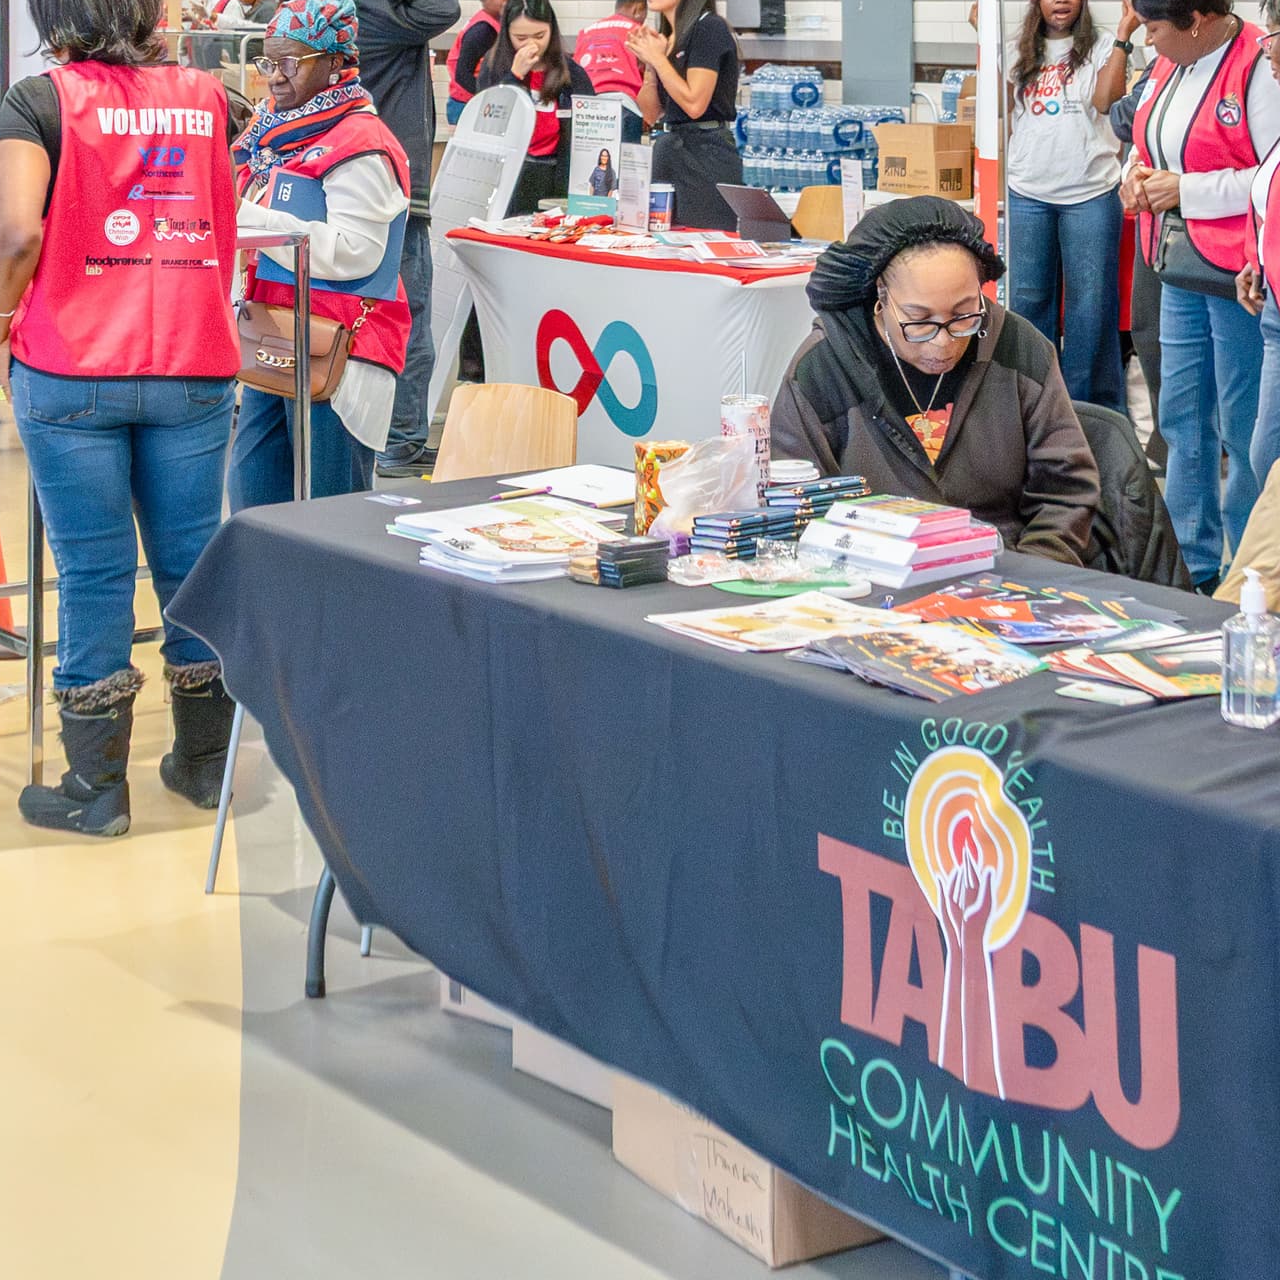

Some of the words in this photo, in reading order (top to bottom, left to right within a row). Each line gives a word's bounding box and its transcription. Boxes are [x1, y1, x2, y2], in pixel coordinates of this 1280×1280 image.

[97, 107, 213, 138] VOLUNTEER
[138, 147, 186, 166] YZD
[884, 166, 907, 178] KIND
[282, 183, 293, 202] YZD
[85, 256, 153, 267] foodpreneur
[85, 266, 103, 276] lab
[921, 718, 1008, 755] GOOD
[891, 741, 918, 784] IN
[883, 788, 904, 840] BE
[820, 1038, 1181, 1254] COMMUNITY
[828, 1104, 973, 1236] HEALTH
[986, 1197, 1185, 1280] CENTR
